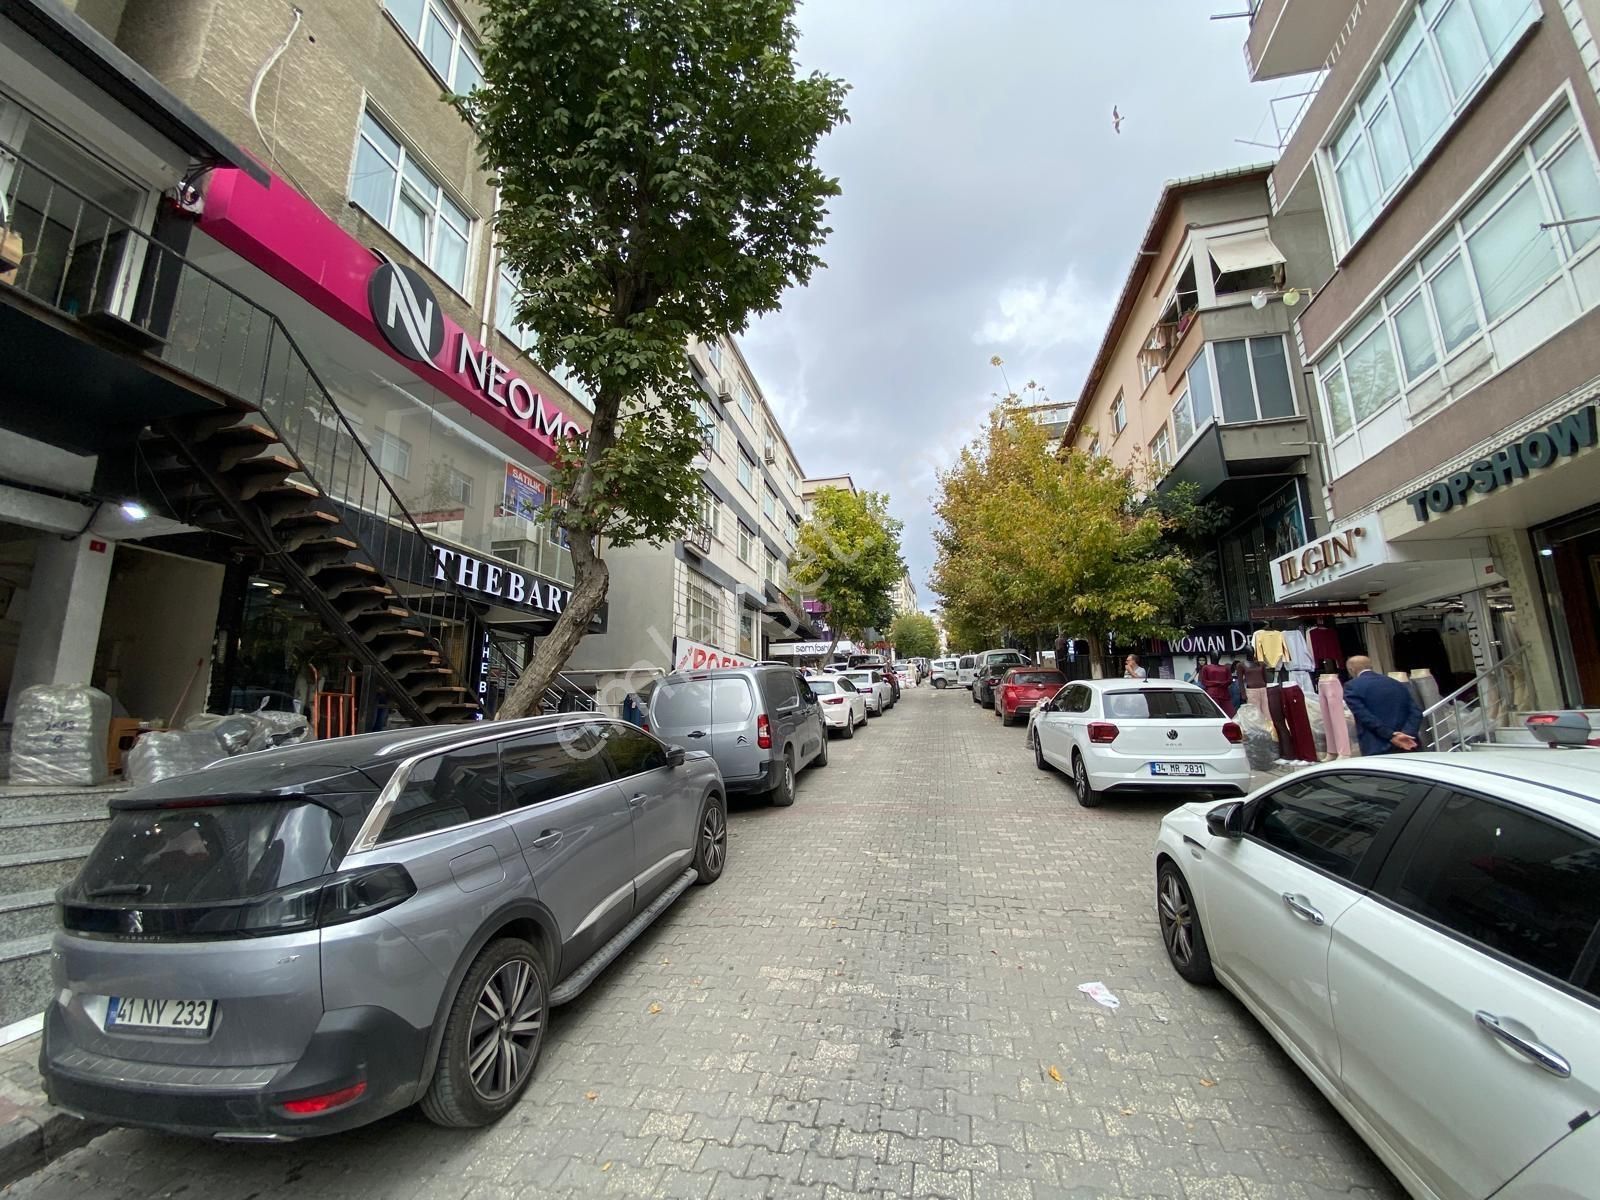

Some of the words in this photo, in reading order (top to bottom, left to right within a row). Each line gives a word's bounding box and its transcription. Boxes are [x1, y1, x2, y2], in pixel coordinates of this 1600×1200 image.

[1407, 405, 1597, 522] TOPSHOW
[1277, 528, 1357, 585] ILGIN
[432, 545, 573, 615] THEBAR
[1308, 573, 1334, 588] LIFE
[1168, 634, 1226, 653] WOMAN
[1155, 763, 1166, 773] 34
[1185, 763, 1204, 774] 2831
[116, 996, 135, 1023] 41
[140, 999, 169, 1025] NY
[172, 1000, 208, 1026] 233
